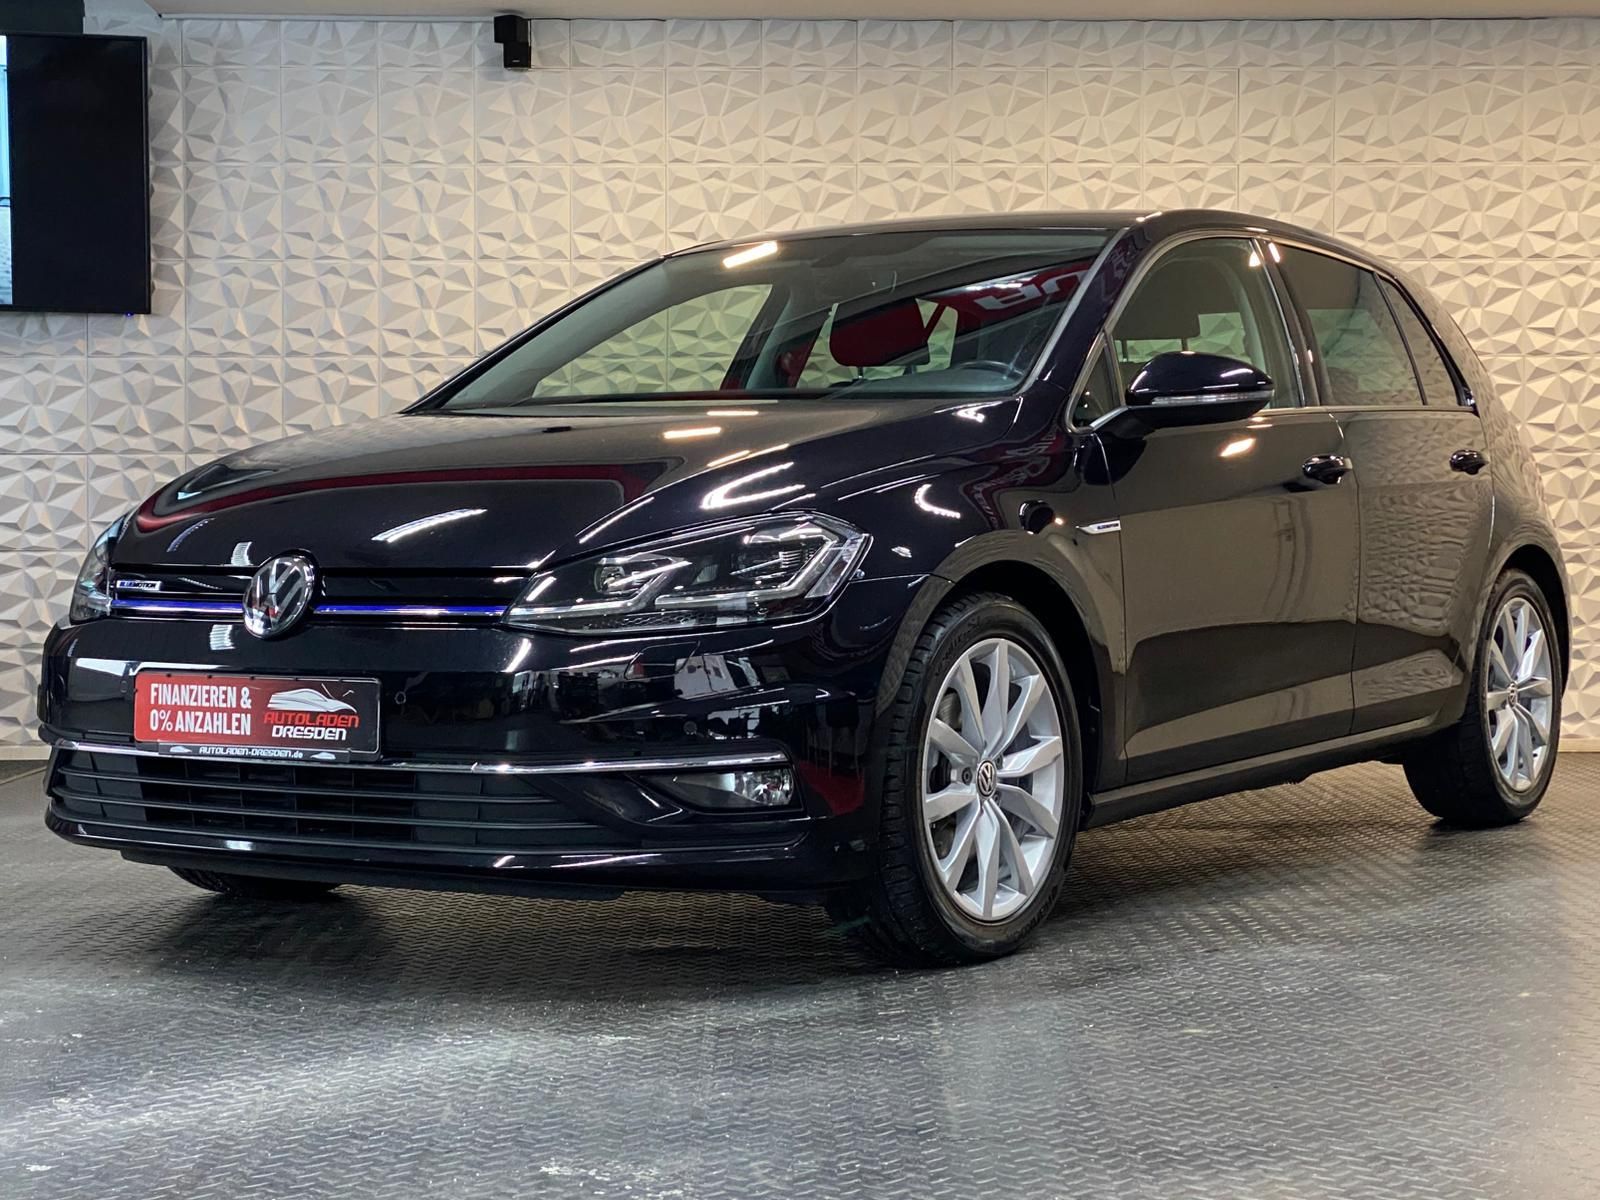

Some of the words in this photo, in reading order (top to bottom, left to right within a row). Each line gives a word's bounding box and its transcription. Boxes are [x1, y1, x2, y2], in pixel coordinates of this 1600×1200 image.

[150, 683, 237, 708] FINANZIEREN
[241, 686, 252, 709] &
[149, 709, 173, 732] 0%
[174, 710, 252, 736] ANZAHLEN
[263, 711, 360, 728] AUTOLADEN
[271, 726, 347, 741] DRESDEN
